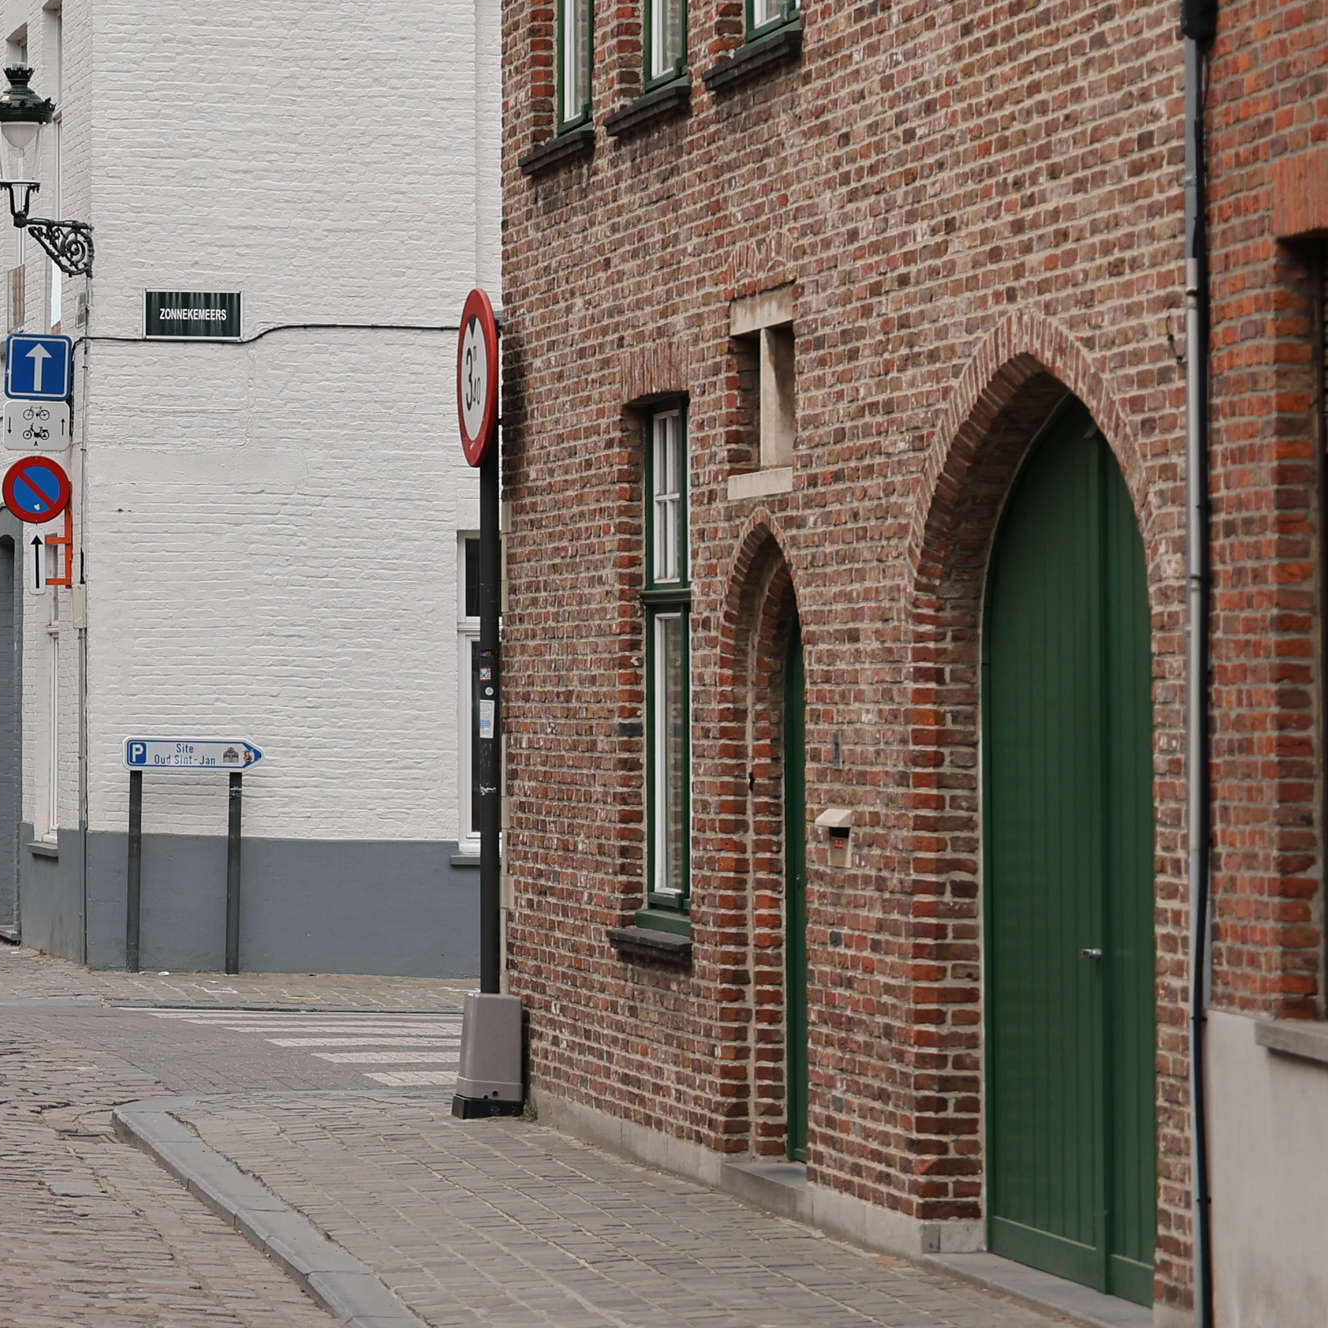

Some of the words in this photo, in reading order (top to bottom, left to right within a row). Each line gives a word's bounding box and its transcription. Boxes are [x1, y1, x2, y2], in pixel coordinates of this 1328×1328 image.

[159, 308, 227, 320] ZONNEKEMEERS
[132, 744, 144, 762] P
[176, 743, 194, 753] Site
[154, 754, 171, 764] Oud
